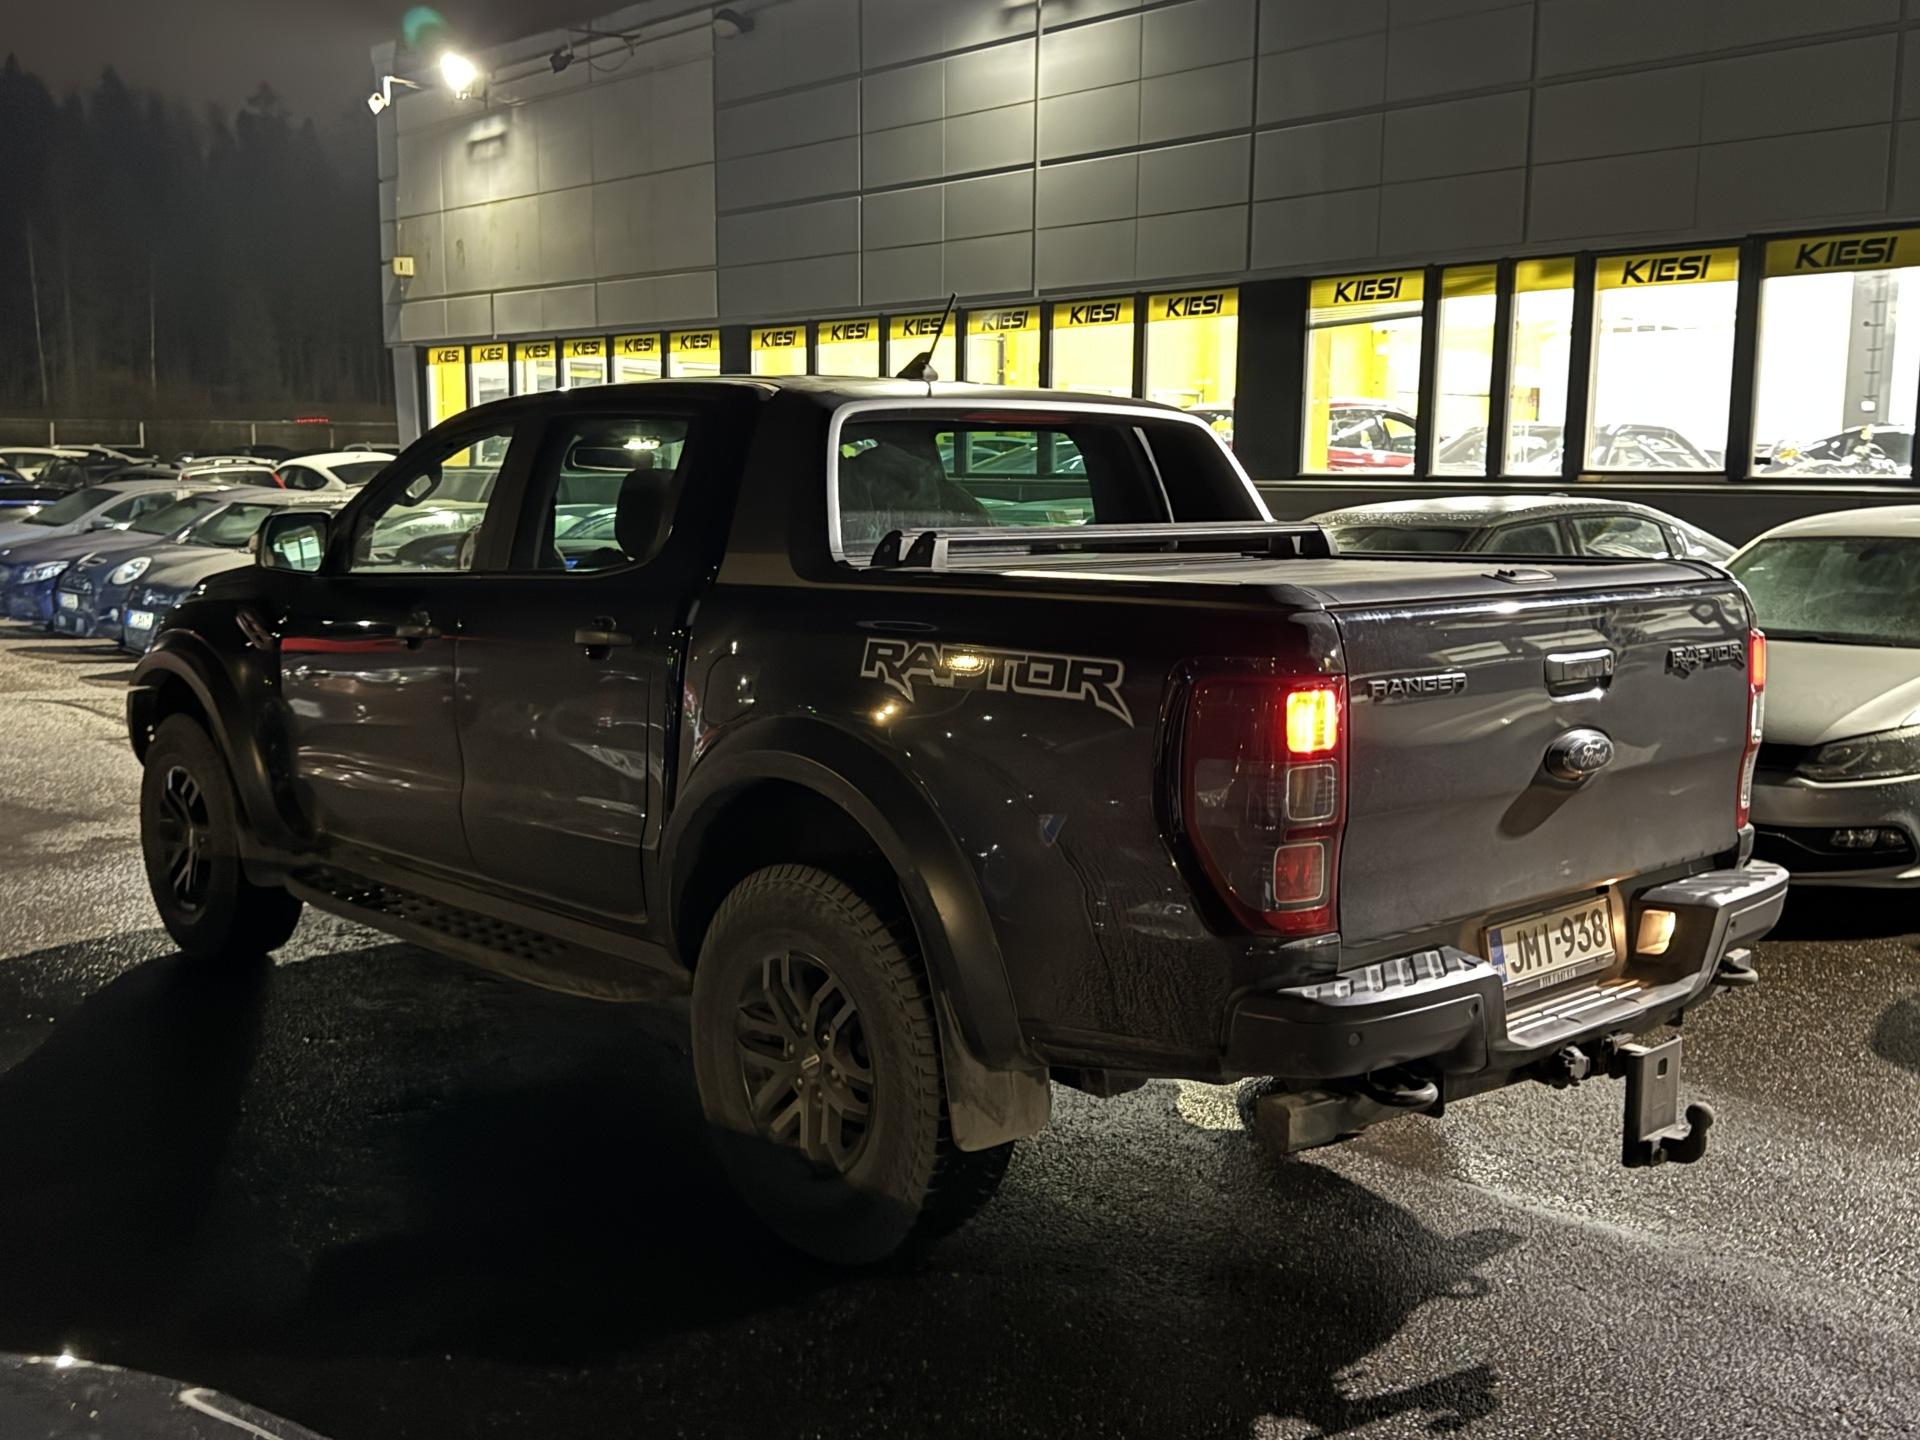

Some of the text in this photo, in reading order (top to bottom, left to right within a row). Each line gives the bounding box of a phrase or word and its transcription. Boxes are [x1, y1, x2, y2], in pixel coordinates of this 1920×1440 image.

[1794, 236, 1899, 270] KIESI
[1621, 254, 1712, 286] KIESI
[1333, 276, 1403, 304] KIESI
[1069, 303, 1121, 325] KIESI
[1166, 294, 1224, 317] KIESI
[831, 322, 870, 341] KIESI
[902, 317, 944, 337] KIES
[981, 310, 1029, 331] KIESI
[573, 341, 601, 356] KIESI
[624, 338, 654, 354] KIESI
[680, 334, 713, 351] KIESI
[760, 330, 797, 348] KIESI
[480, 347, 504, 361] KIESI
[524, 343, 551, 359] KIESI
[1666, 643, 1744, 679] RAPTOR
[860, 637, 1134, 728] RAPTOR
[1368, 672, 1467, 702] RANGER
[1580, 740, 1609, 769] Ford
[1510, 908, 1606, 973] JMI-938
